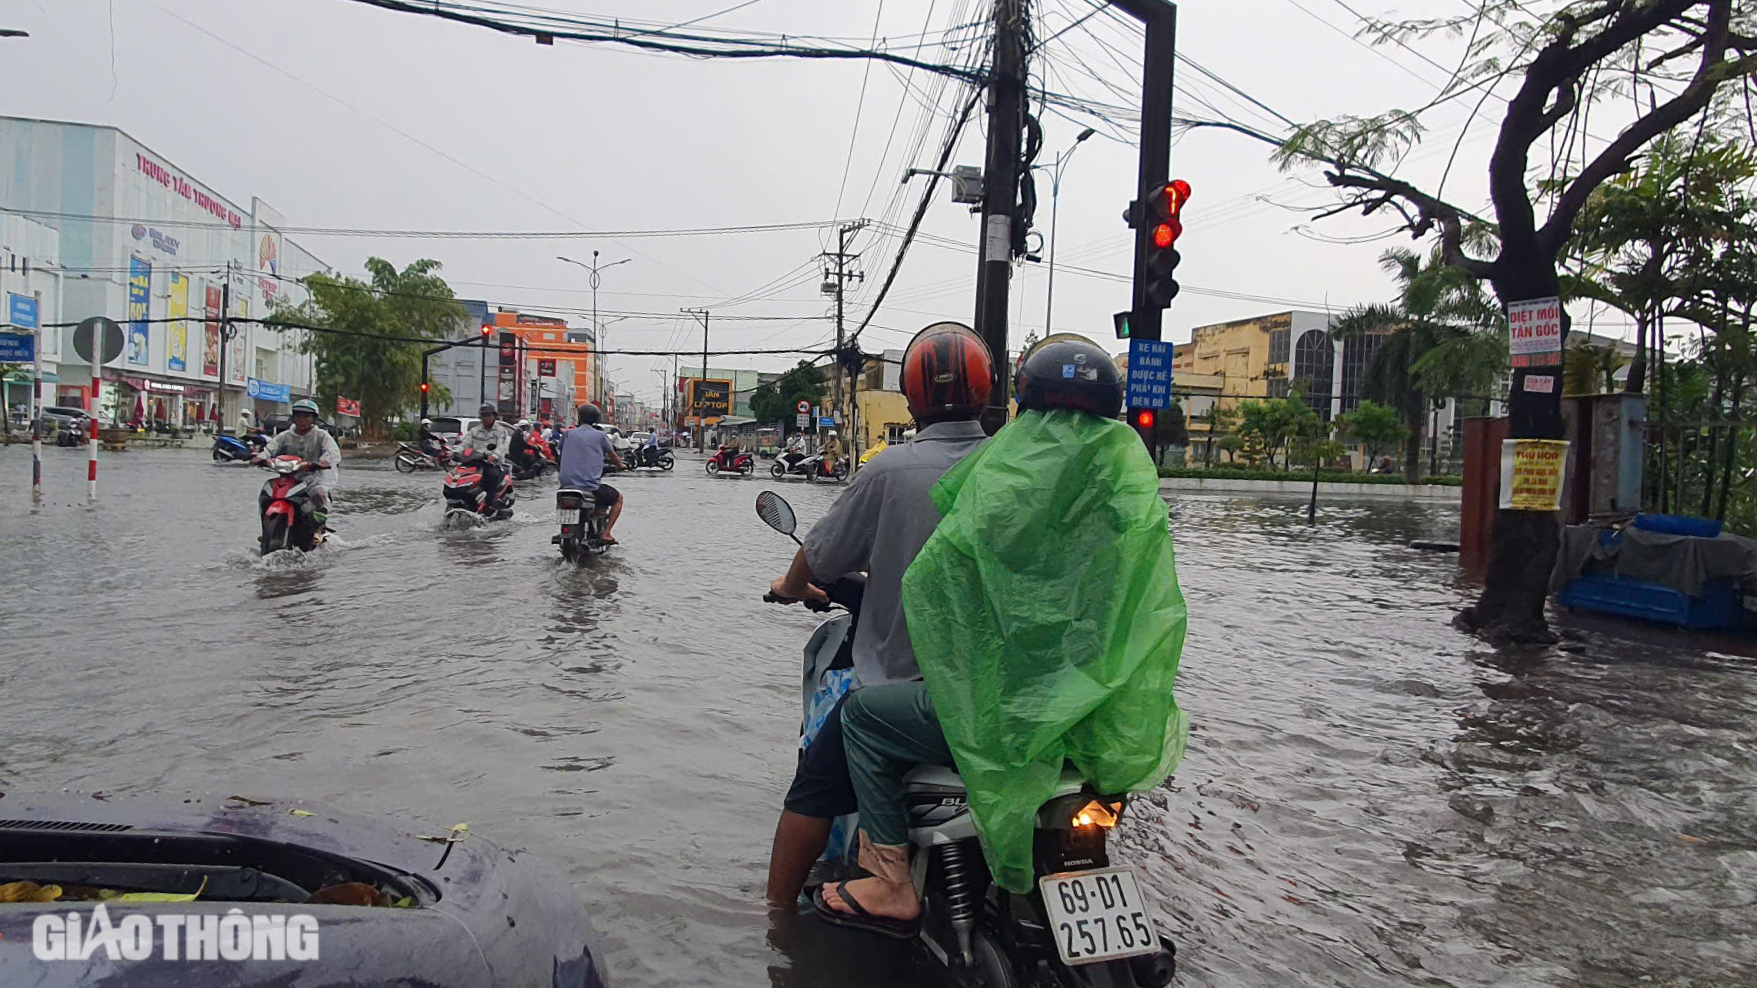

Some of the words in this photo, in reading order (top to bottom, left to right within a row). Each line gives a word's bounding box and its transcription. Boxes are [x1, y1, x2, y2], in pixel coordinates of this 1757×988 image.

[1510, 309, 1533, 325] DIỆT
[1537, 303, 1558, 320] MỐI
[1536, 322, 1558, 337] GỐC
[1138, 343, 1150, 353] XE
[1152, 343, 1166, 353] HAI
[1140, 355, 1162, 366] BÁNH
[1152, 384, 1166, 394] KHI
[942, 797, 967, 807] BL
[1060, 912, 1151, 958] 257.65
